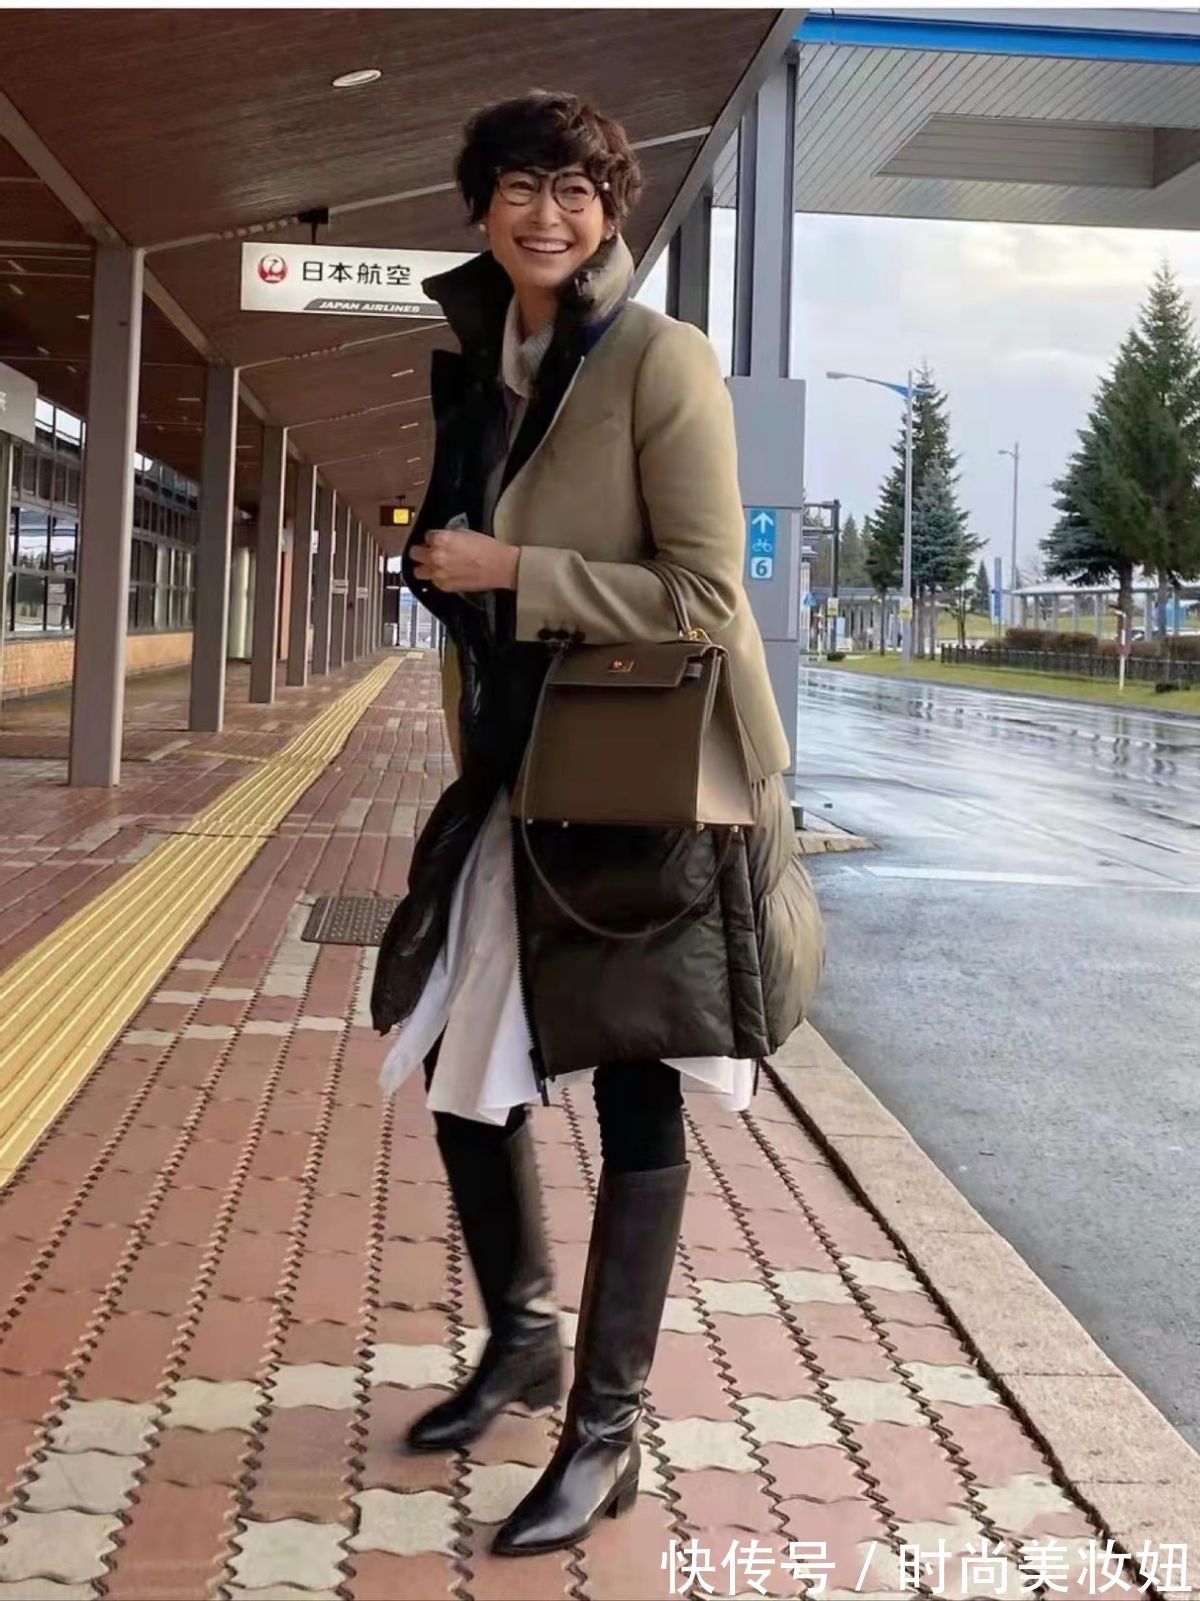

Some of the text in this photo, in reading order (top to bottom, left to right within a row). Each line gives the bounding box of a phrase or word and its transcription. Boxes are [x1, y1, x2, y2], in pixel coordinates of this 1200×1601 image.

[302, 261, 411, 286] 日本航空
[319, 301, 421, 313] JAPAN AIRLINES
[755, 559, 768, 577] 6
